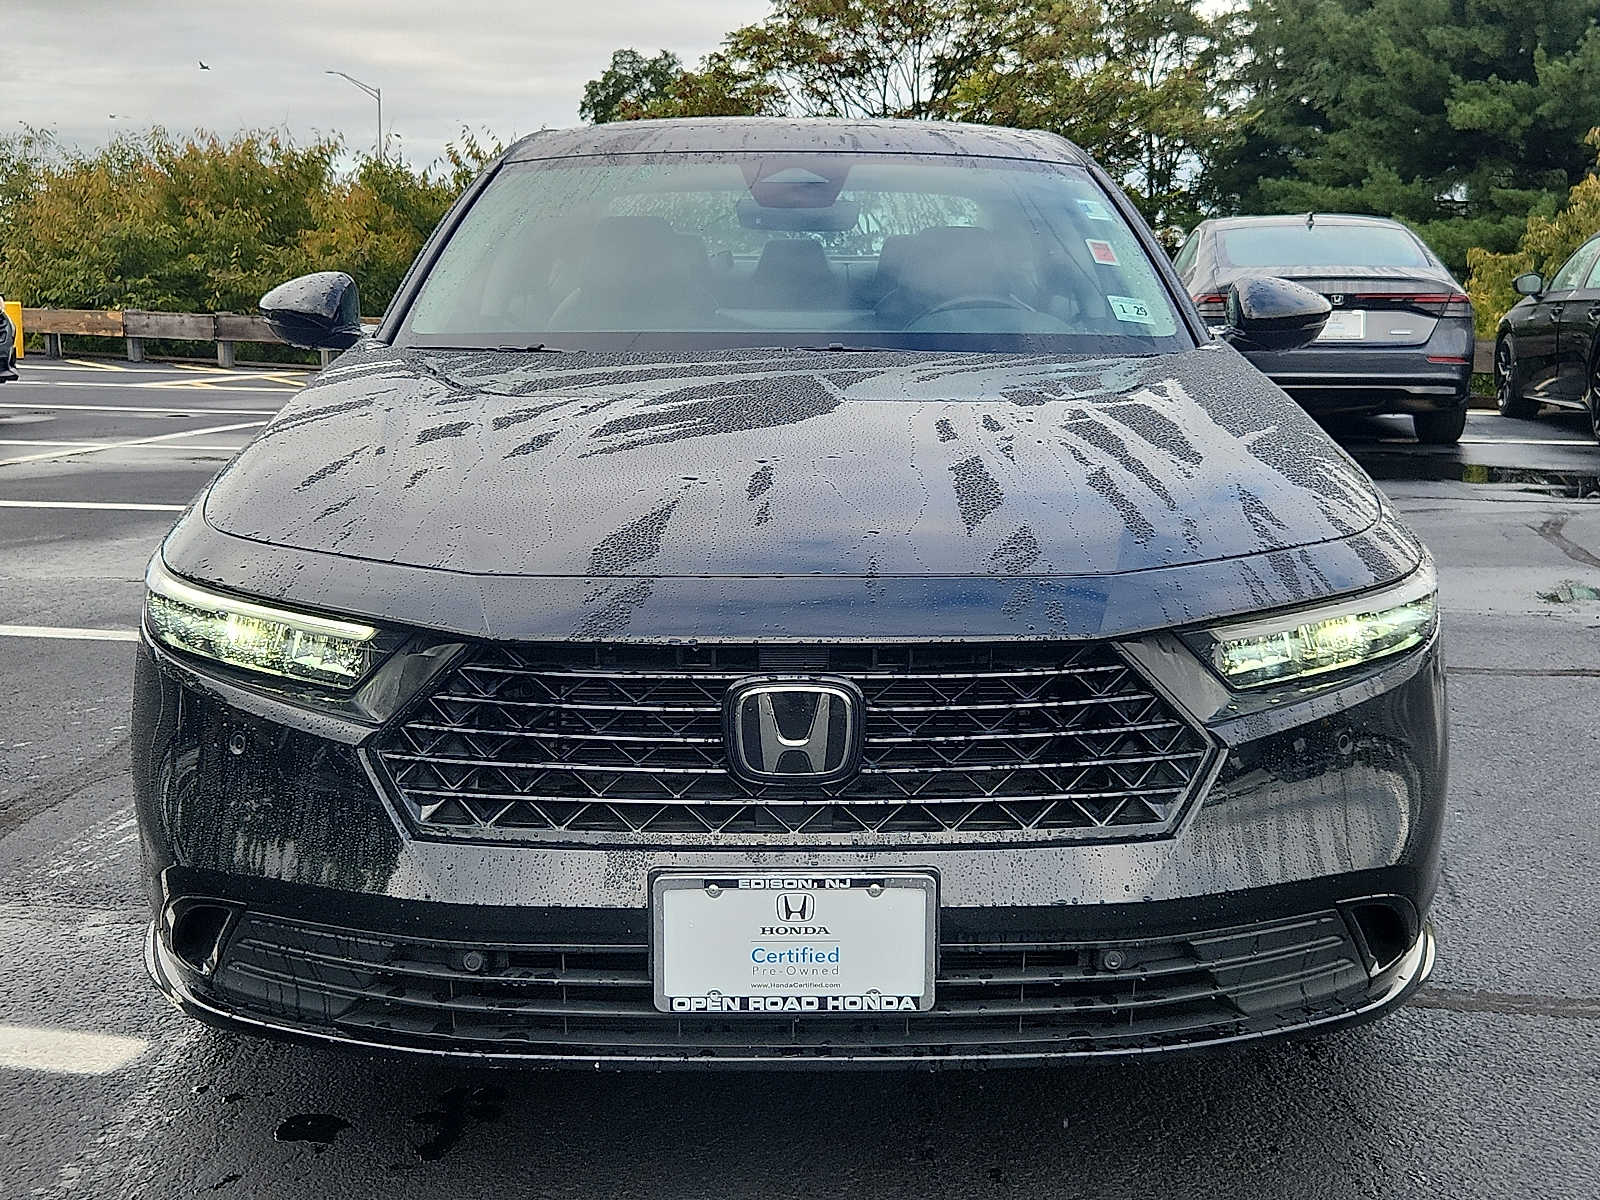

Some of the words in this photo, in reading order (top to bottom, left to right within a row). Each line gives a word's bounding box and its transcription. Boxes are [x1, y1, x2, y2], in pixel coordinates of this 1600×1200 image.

[1119, 304, 1127, 314] 1
[1133, 305, 1148, 317] 29
[738, 878, 818, 889] EDISON,
[825, 878, 851, 889] NJ
[760, 926, 831, 935] HONDA
[751, 946, 839, 963] Certified
[752, 965, 839, 976] Pre-Owned
[672, 996, 740, 1011] OPEN
[748, 996, 819, 1011] ROAD
[827, 996, 917, 1011] HONDA
